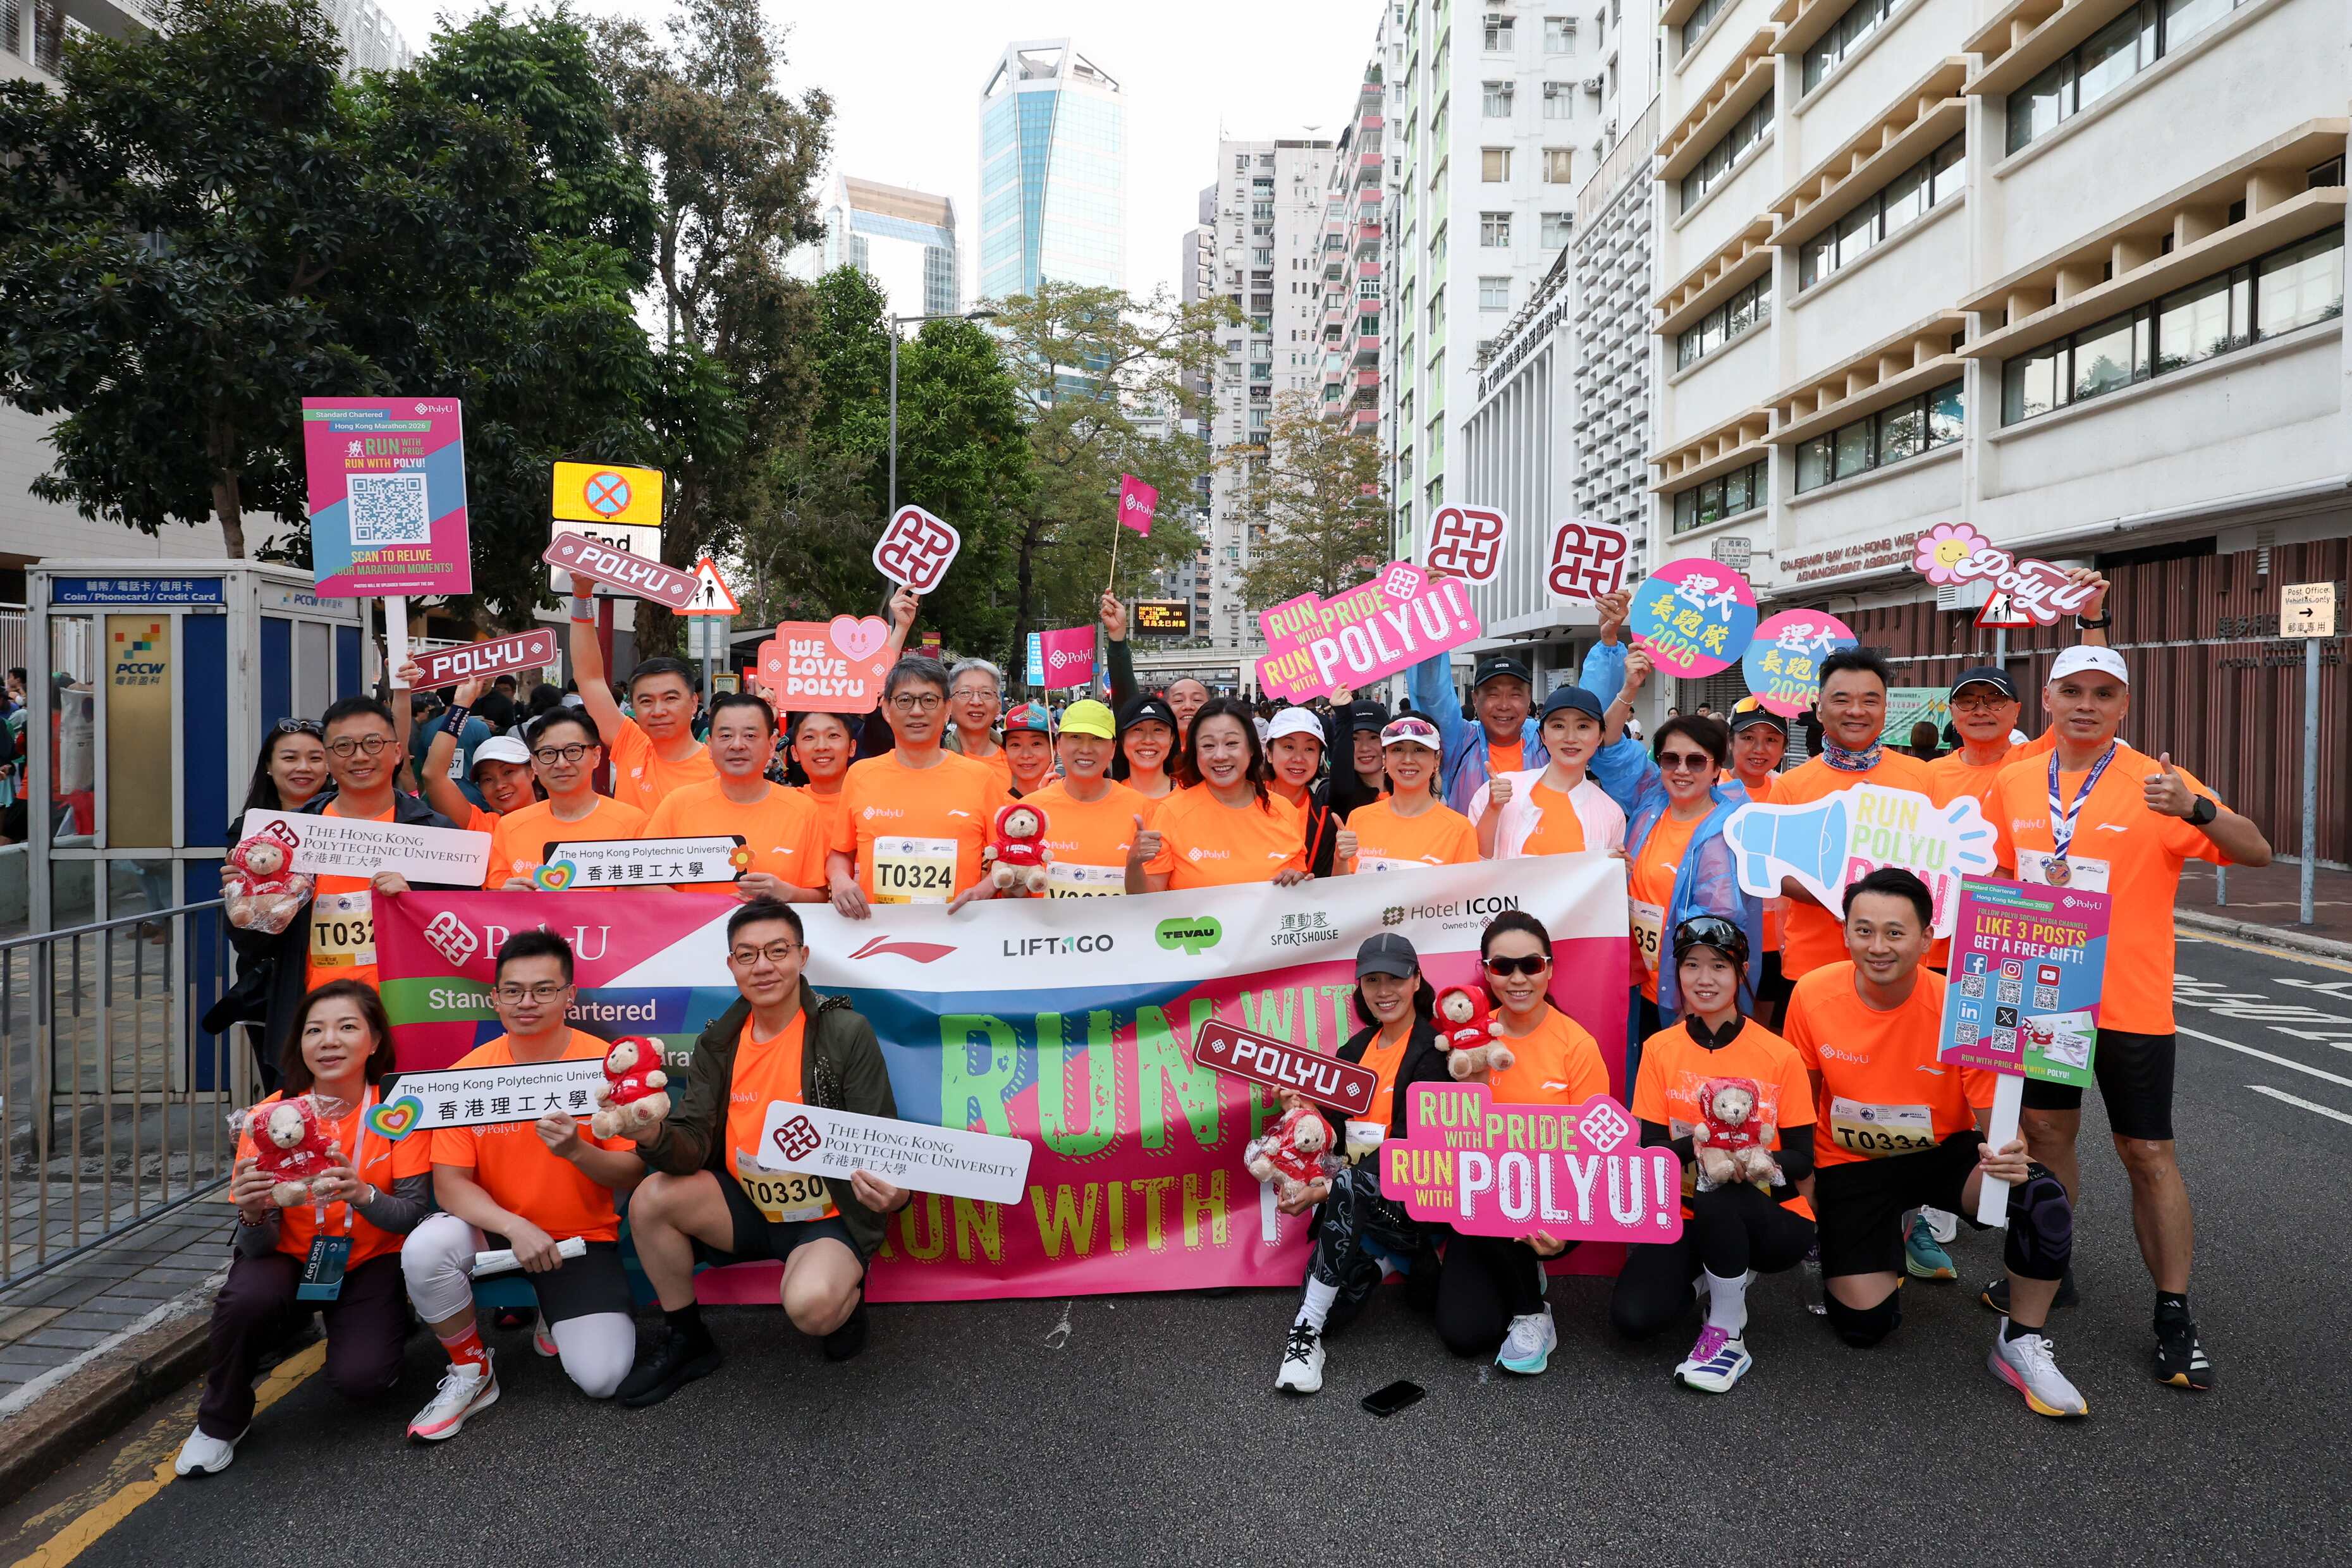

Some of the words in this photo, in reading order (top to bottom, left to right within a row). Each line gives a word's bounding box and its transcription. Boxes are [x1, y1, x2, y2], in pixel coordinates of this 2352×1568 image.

[428, 405, 453, 414] PolyU
[365, 438, 400, 456] RUN
[401, 438, 421, 446] WITH
[401, 446, 425, 456] PRIDE
[345, 458, 365, 469] RUN
[367, 458, 391, 468] WITH
[393, 458, 426, 468] POLYU!
[351, 549, 379, 563] SCAN
[381, 549, 395, 562] TO
[397, 549, 432, 561] RELIVE
[1780, 553, 1824, 572] CAUSEWAY
[1825, 549, 1843, 562] BAY
[357, 564, 407, 575] MARATHON
[408, 562, 454, 574] MOMENTS!
[575, 546, 671, 592] POLYU
[1952, 548, 2097, 622] PolyU
[64, 592, 88, 601] Coin
[95, 592, 149, 601] Phonecard
[156, 592, 188, 601] Credit
[191, 592, 216, 601] Card
[294, 593, 319, 606] PCCW
[1674, 573, 1738, 622] 理大
[1267, 600, 1319, 640] RUN
[1294, 625, 1325, 646] WITH
[1320, 584, 1392, 633] PRIDE
[1650, 594, 1730, 656] 長跑隊
[1263, 651, 1314, 687] RUN
[1289, 673, 1319, 694] WITH
[1310, 583, 1473, 689] POLYU!
[2288, 622, 2325, 633] 郵車專用
[788, 639, 826, 658] WE
[1645, 623, 1700, 668] 2026
[1775, 623, 1836, 656] 理大
[433, 640, 524, 680] POLYU
[1068, 648, 1094, 664] PolyU
[1759, 649, 1820, 682] 長跑
[115, 663, 166, 674] PCCW
[787, 658, 848, 677] LOVE
[115, 676, 161, 686] 電訊盈科
[787, 677, 866, 697] POLYU
[1766, 677, 1820, 709] 2026
[876, 807, 904, 818] PolyU
[1856, 792, 1920, 832] RUN
[306, 825, 336, 838] THE
[340, 828, 383, 842] HONG
[386, 833, 424, 847] KONG
[1051, 841, 1079, 852] PolyU
[1851, 824, 1947, 870] POLYU
[302, 851, 383, 868] 香港理工大學
[303, 838, 401, 857] POLYTECHNIC
[405, 847, 481, 864] UNIVERSITY
[560, 850, 577, 859] The
[580, 850, 604, 859] Hong
[606, 848, 630, 859] Kong
[633, 846, 684, 858] Polytechnic
[687, 844, 730, 856] University
[1203, 848, 1230, 861] PolyU
[587, 862, 704, 881] 香港理工大學
[878, 864, 952, 889] T0324
[1963, 883, 1988, 891] Standard
[1988, 886, 2016, 895] Chartered
[1976, 893, 1992, 902] Hong
[1992, 896, 2007, 904] Kong
[2007, 898, 2034, 907] Marathon
[1411, 902, 1460, 920] Hotel
[1466, 895, 1519, 915] ICON
[2076, 900, 2102, 910] PolyU
[1281, 910, 1331, 931] 運動家
[1442, 921, 1467, 930] Owned
[1469, 921, 1479, 931] by
[1978, 908, 2000, 917] FOLLOW
[2000, 911, 2019, 919] POLYU
[2019, 914, 2038, 922] SOCIAL
[2040, 916, 2057, 925] MEDIA
[2059, 919, 2088, 929] CHANNELS
[314, 919, 375, 946] T032
[1163, 927, 1215, 940] TEVAU
[1271, 928, 1339, 946] SPORTSHOUSE
[1976, 915, 2013, 937] LIKE
[2018, 921, 2028, 940] 3
[2031, 923, 2087, 948] POSTS
[1974, 934, 1999, 950] GET
[2001, 938, 2011, 953] A
[2014, 941, 2047, 960] FREE
[2050, 945, 2085, 964] GIFT!
[1230, 1036, 1345, 1096] POLYU
[1835, 1049, 1870, 1065] PolyU
[1961, 1053, 1975, 1063] RUN
[1976, 1057, 1993, 1065] WITH
[1994, 1060, 2013, 1069] PRIDE
[2014, 1063, 2026, 1072] RUN
[2028, 1066, 2046, 1075] WITH
[2047, 1068, 2070, 1079] POLYU!
[401, 1084, 424, 1095] The
[428, 1082, 460, 1093] Hong
[463, 1079, 494, 1091] Kong
[497, 1072, 563, 1087] Polytechnic
[567, 1070, 607, 1081] Univers
[940, 993, 1227, 1160] RUN
[438, 1089, 588, 1121] 香港理工大學
[732, 1091, 758, 1104] PolyU
[1418, 1089, 1483, 1131] RUN
[486, 1123, 520, 1136] PolyU
[828, 1122, 860, 1139] THE
[864, 1129, 908, 1147] HONG
[912, 1136, 953, 1155] KONG
[1445, 1129, 1483, 1149] WITH
[1485, 1112, 1579, 1153] PRIDE
[1837, 1126, 1933, 1151] T0334
[822, 1152, 907, 1176] 香港理工大學
[824, 1137, 928, 1165] POLYTECHNIC
[932, 1153, 1018, 1177] UNIVERSITY
[1390, 1148, 1455, 1189] RUN
[742, 1175, 824, 1204] T0330
[1414, 1187, 1454, 1209] WITH
[1457, 1150, 1672, 1232] POLYU!
[1029, 1168, 1232, 1260] WITH
[311, 1241, 323, 1261] Race
[305, 1263, 317, 1280] Day
